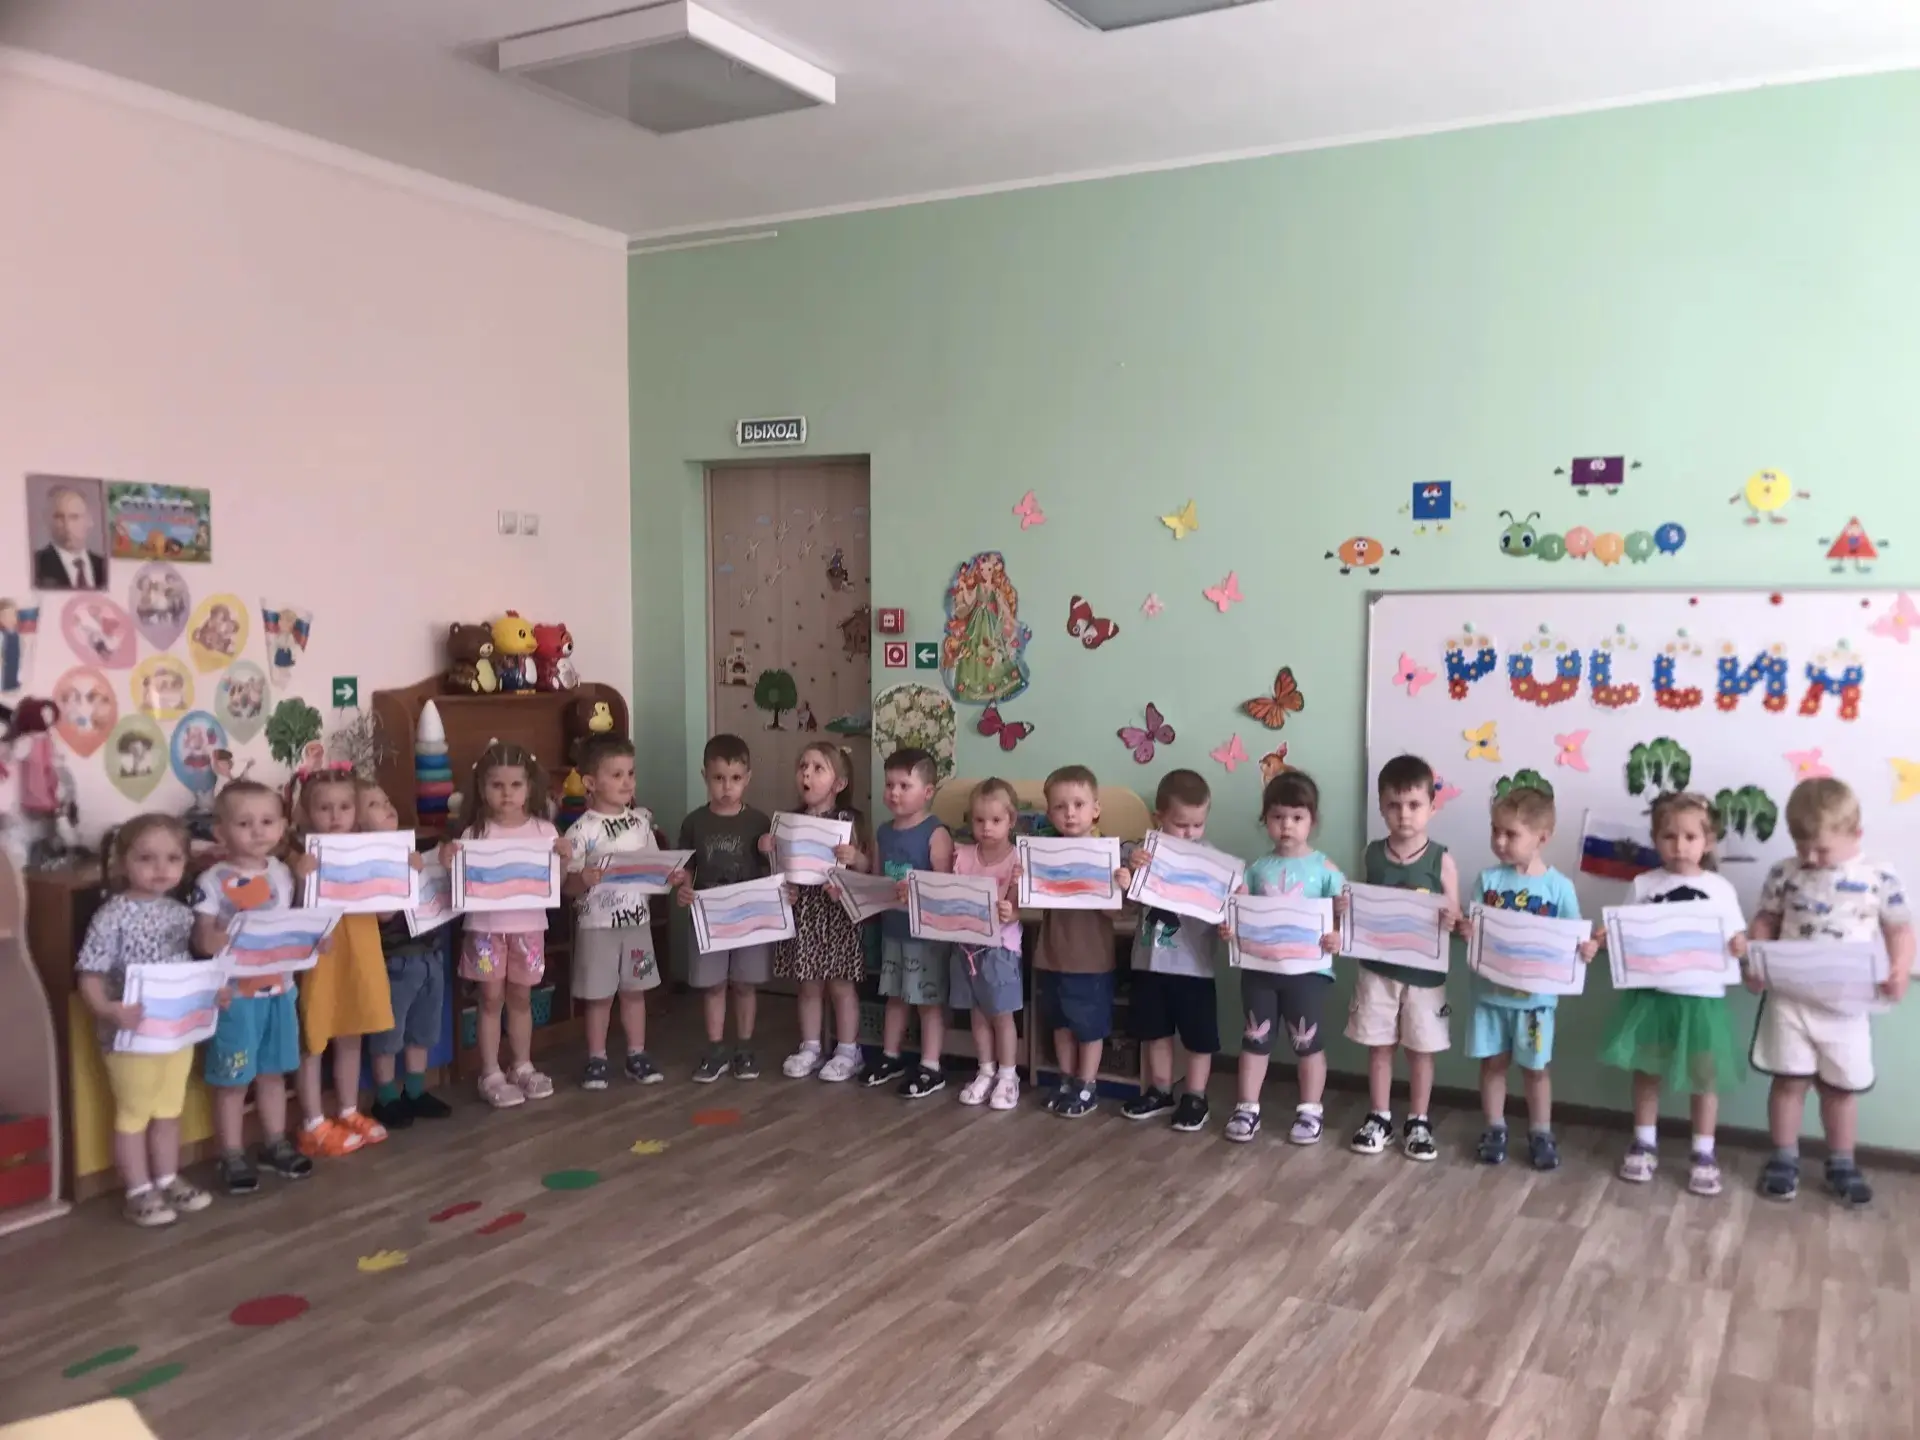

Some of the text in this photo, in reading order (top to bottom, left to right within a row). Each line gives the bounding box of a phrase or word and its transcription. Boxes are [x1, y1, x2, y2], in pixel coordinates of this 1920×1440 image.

[744, 422, 798, 440] ВЫХОД
[1638, 538, 1648, 551] 4
[1443, 634, 1866, 722] РОССИЯ
